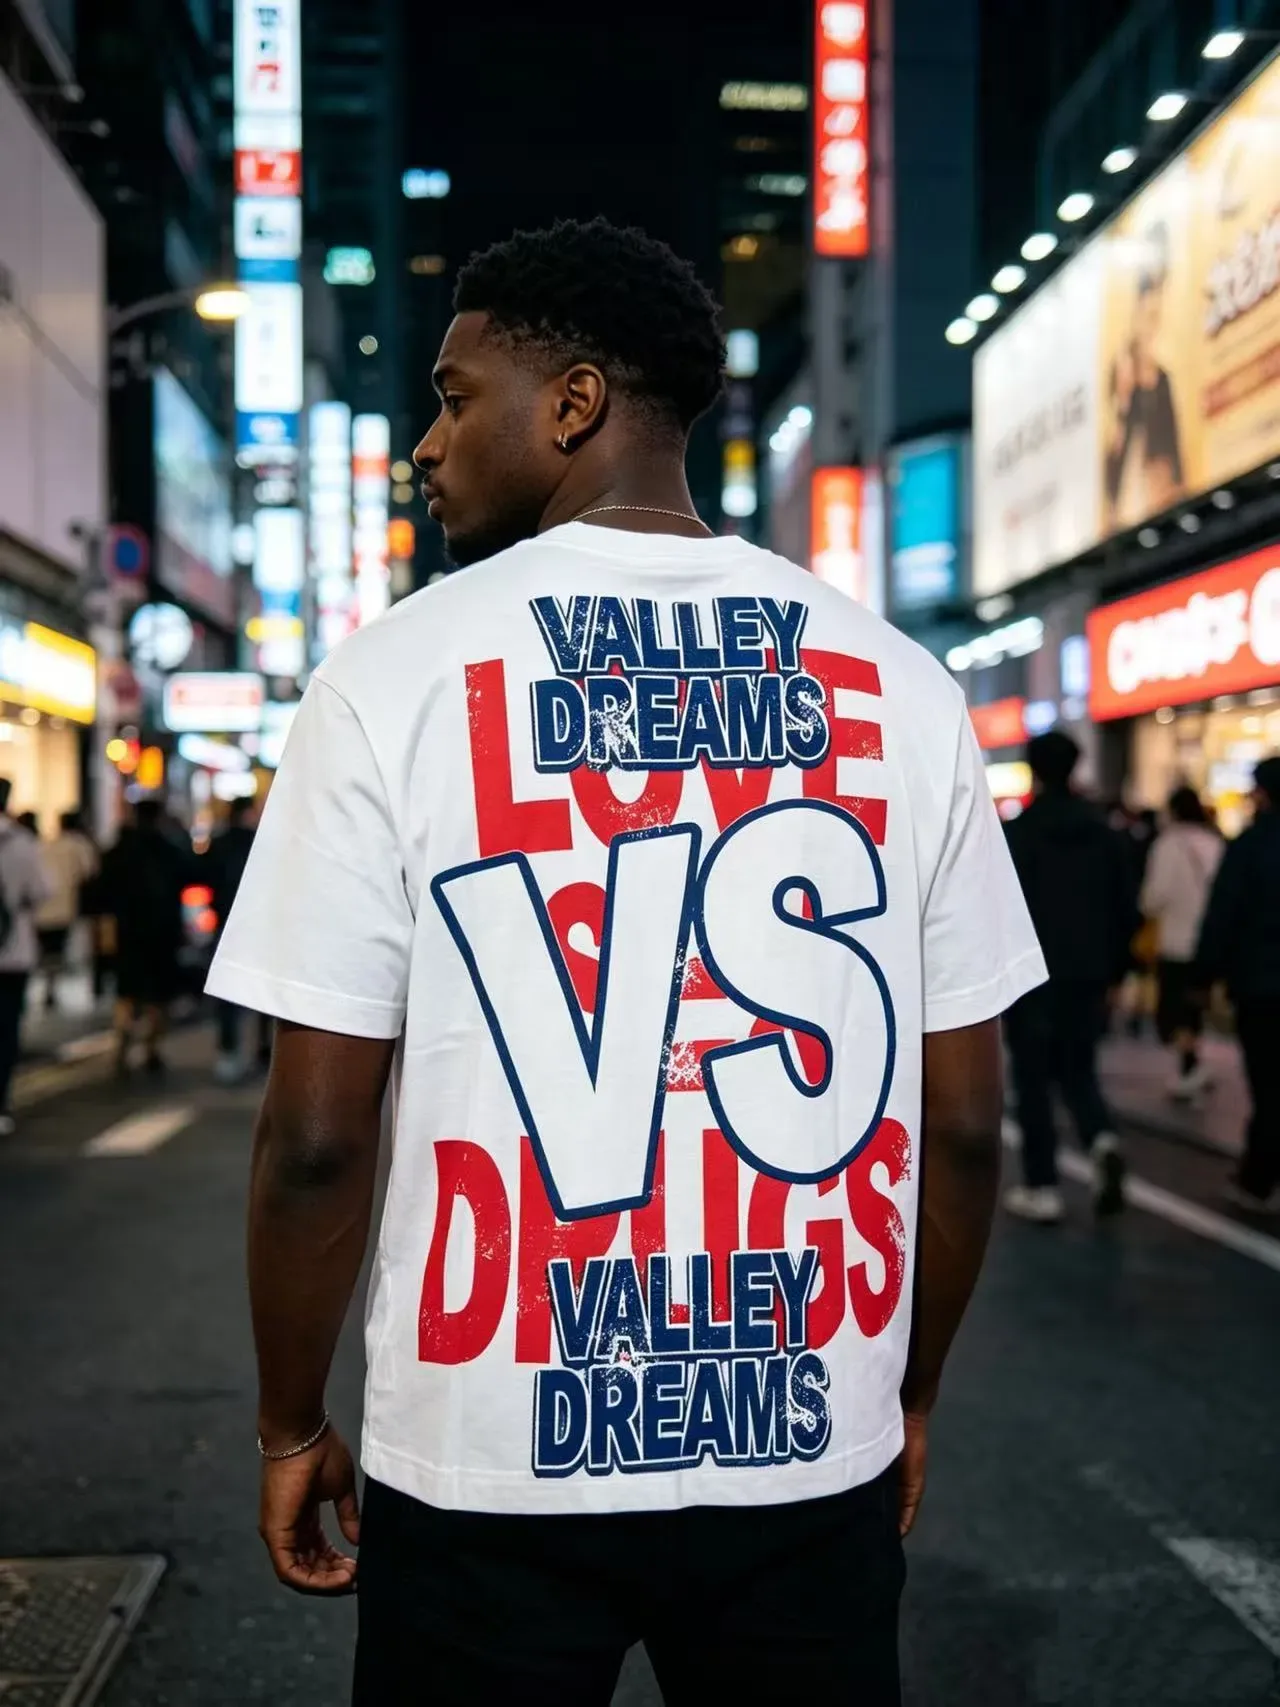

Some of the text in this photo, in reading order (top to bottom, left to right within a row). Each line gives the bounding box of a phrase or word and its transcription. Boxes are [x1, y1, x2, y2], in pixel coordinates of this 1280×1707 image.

[529, 595, 808, 680] VALLEY
[530, 671, 832, 773] DREAMS
[430, 799, 897, 1221] VS
[547, 1247, 819, 1371] VALLEY
[532, 1350, 833, 1479] DREAMS
